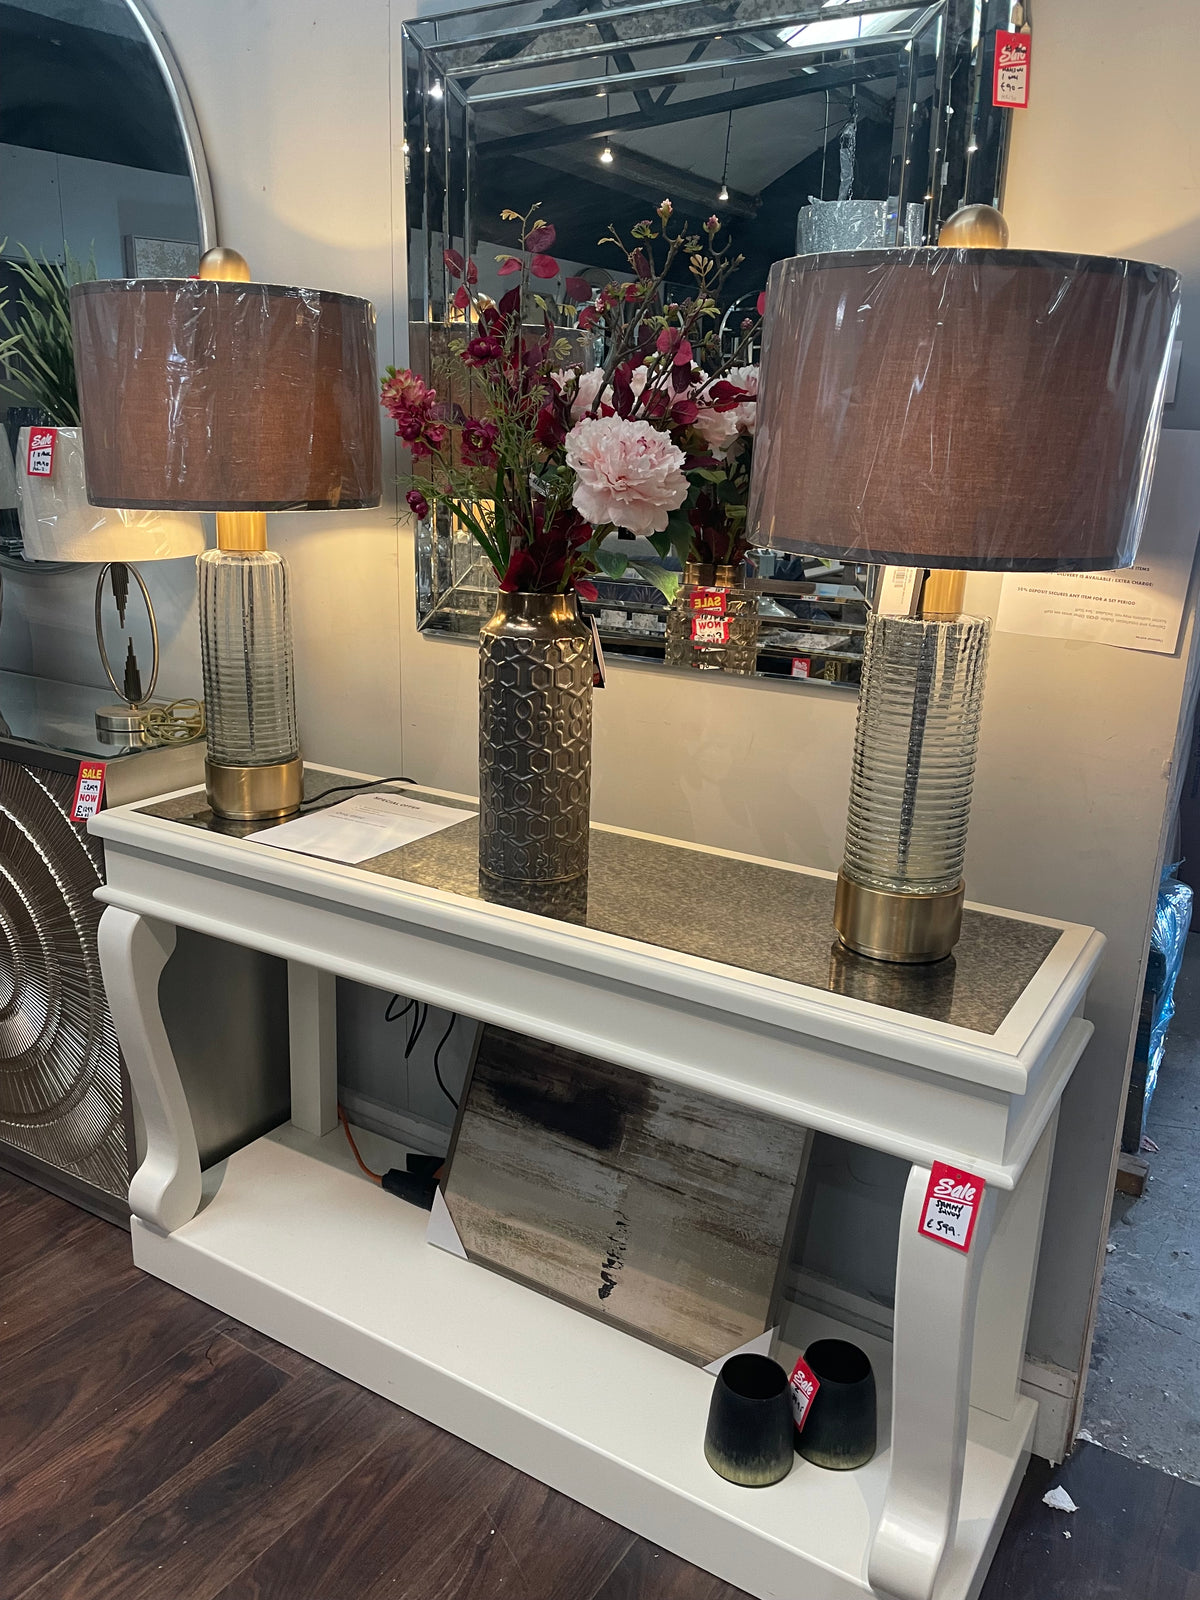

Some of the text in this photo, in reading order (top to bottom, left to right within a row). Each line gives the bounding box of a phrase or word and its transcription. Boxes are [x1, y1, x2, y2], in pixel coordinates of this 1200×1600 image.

[32, 433, 53, 447] Sale
[1085, 574, 1112, 582] AVAILABLE
[1048, 590, 1069, 598] SECURES
[82, 768, 103, 780] SALE
[79, 793, 98, 803] NOW
[933, 1178, 977, 1202] Sale
[793, 1370, 815, 1396] Sale
